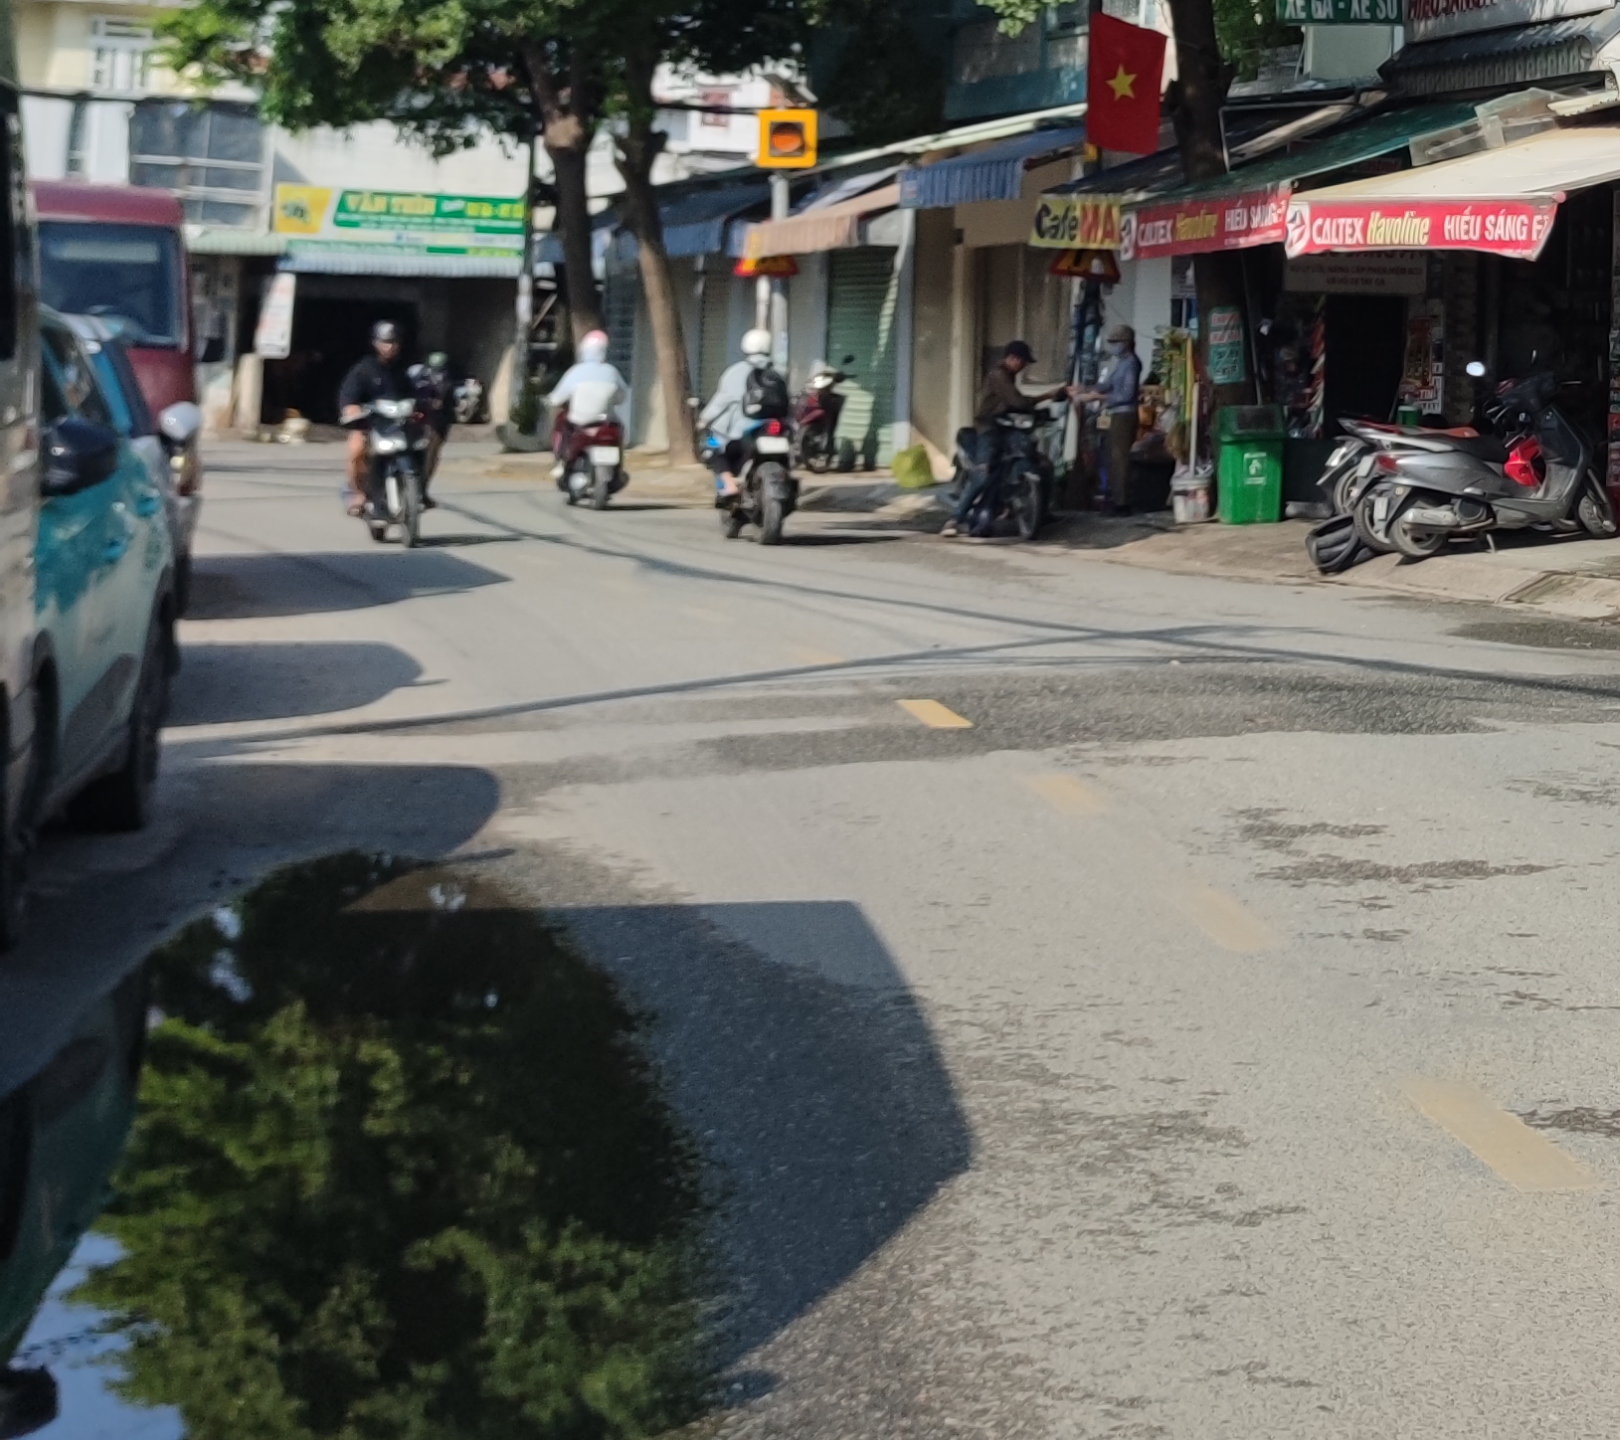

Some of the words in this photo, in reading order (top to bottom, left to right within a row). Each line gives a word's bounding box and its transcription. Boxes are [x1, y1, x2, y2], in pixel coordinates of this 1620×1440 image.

[1312, 216, 1364, 245] CALTEX
[1366, 210, 1431, 246] Havoline
[1443, 206, 1481, 242] HIẾU
[1484, 208, 1528, 242] SÁNG
